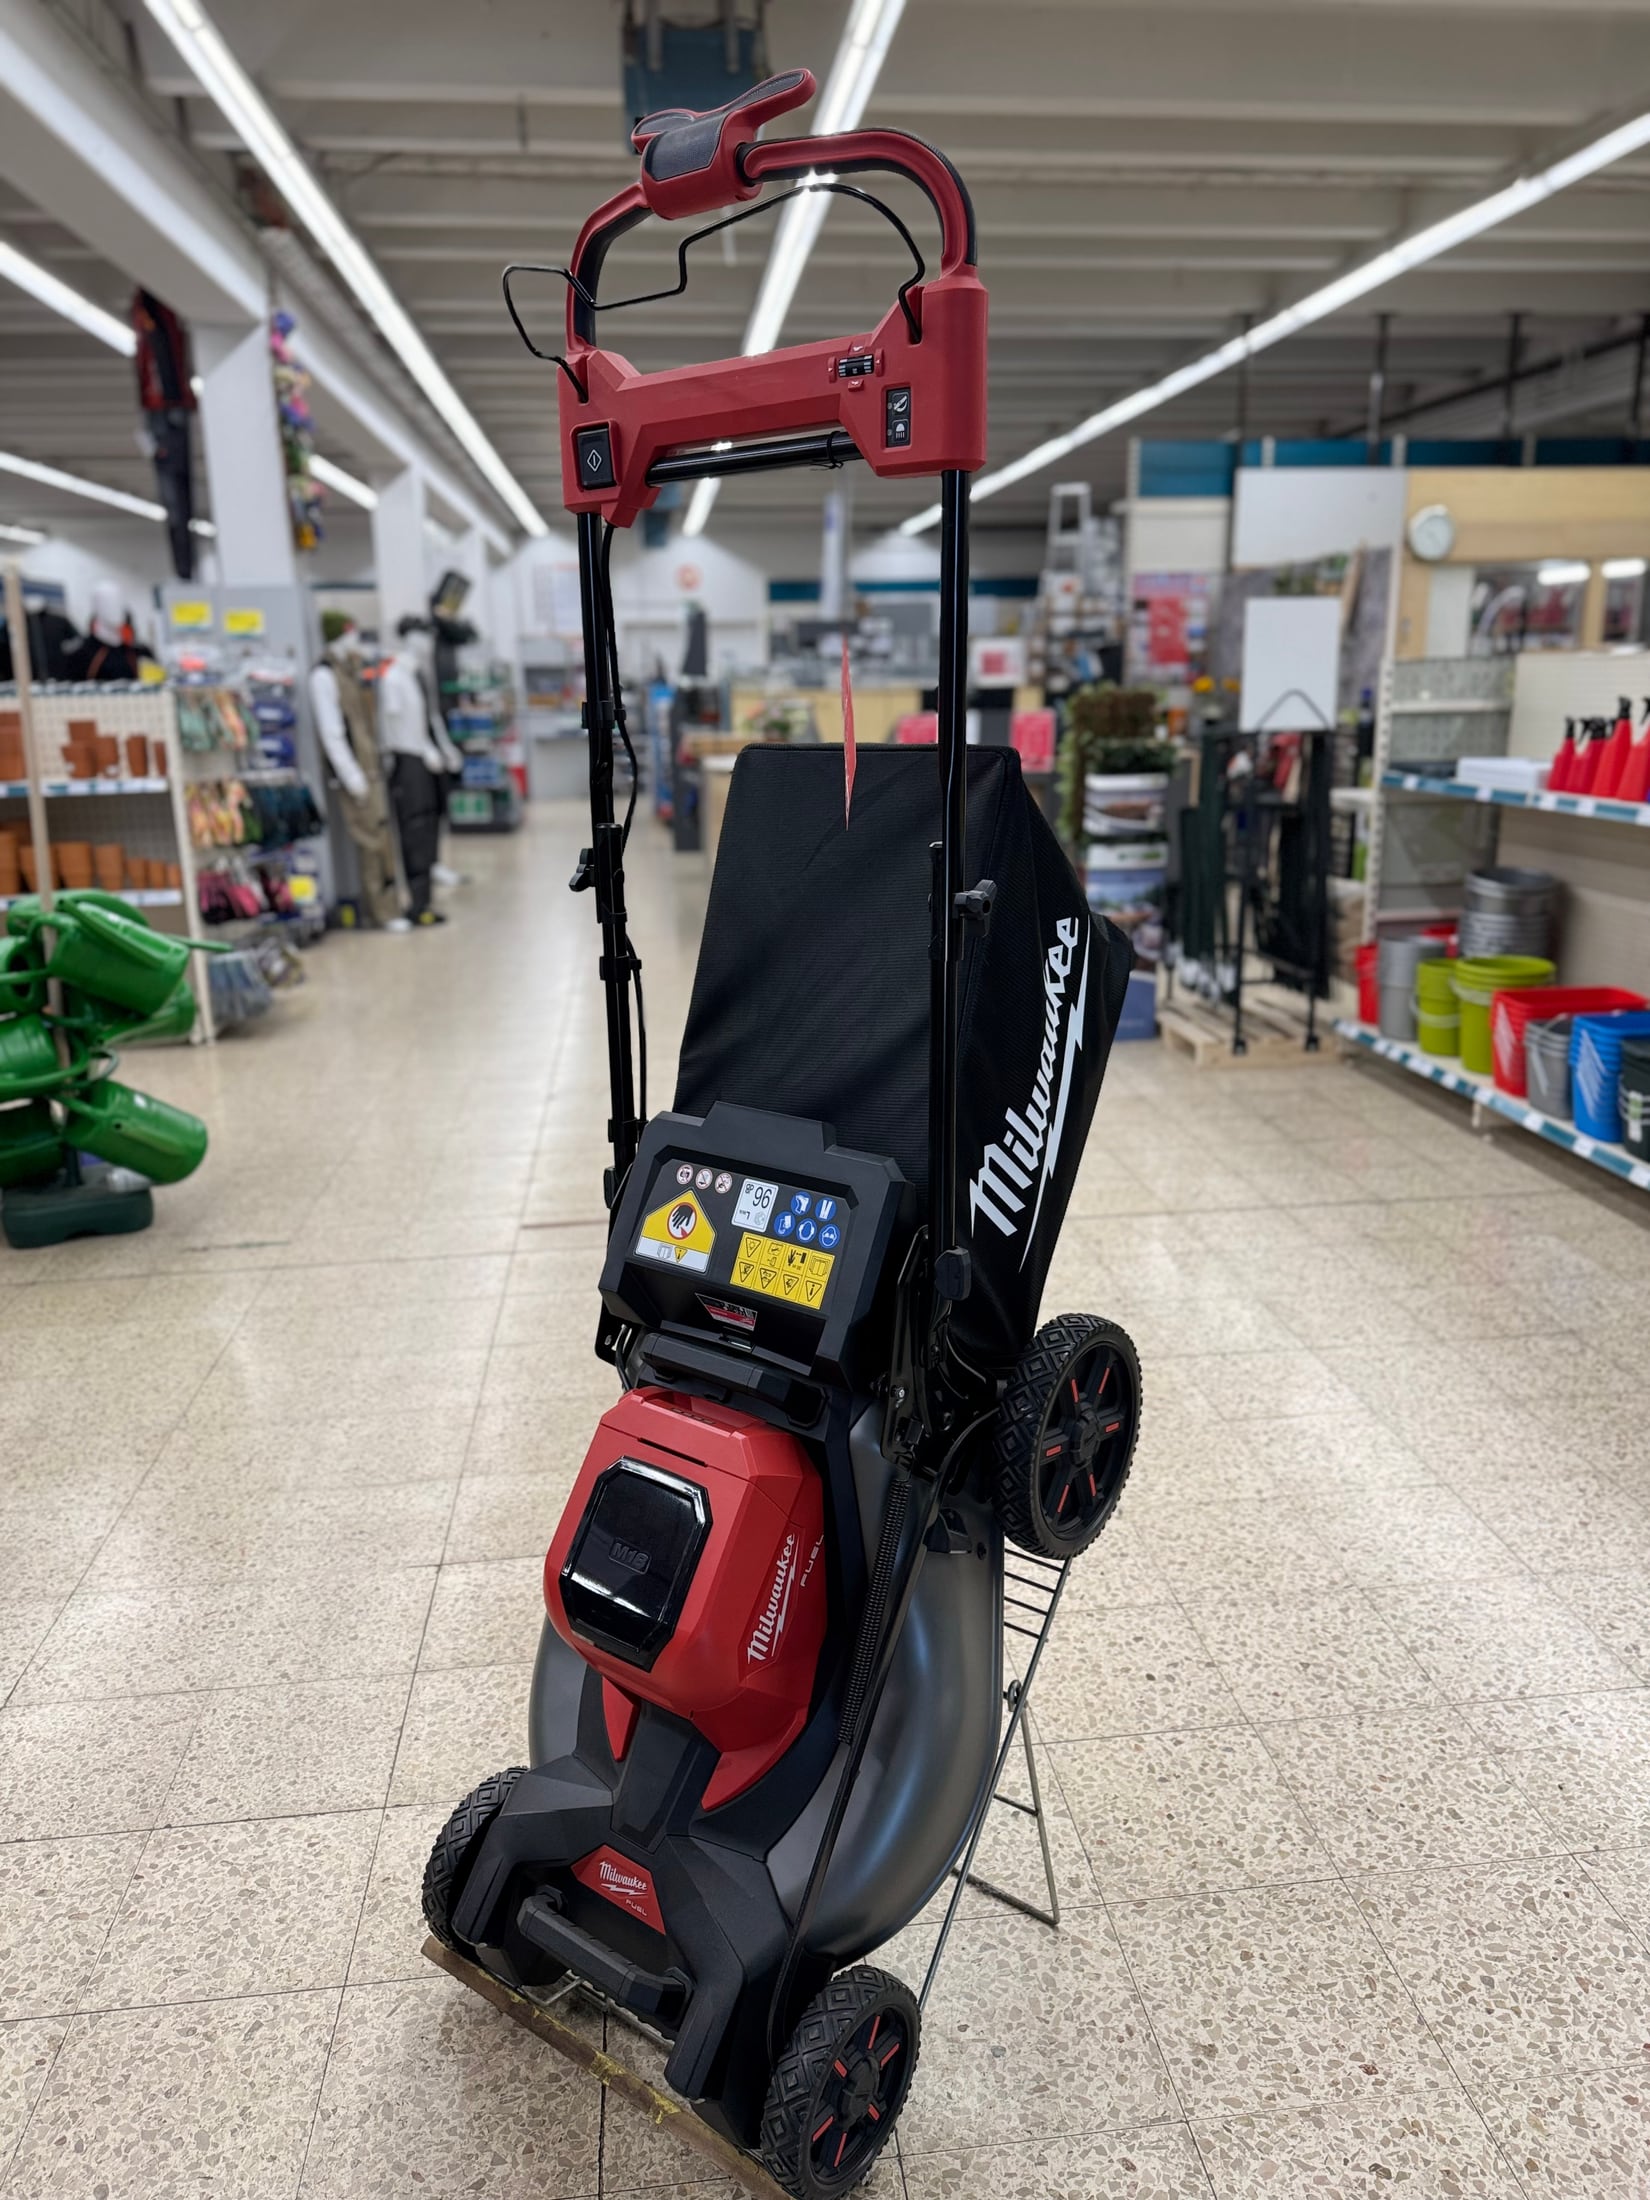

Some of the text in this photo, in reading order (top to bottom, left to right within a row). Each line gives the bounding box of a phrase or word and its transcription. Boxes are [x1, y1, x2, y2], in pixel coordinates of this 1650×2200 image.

[969, 917, 1079, 1239] Milwaukee
[752, 1186, 773, 1209] 96
[611, 1542, 649, 1570] M18
[800, 1534, 824, 1587] FUEL
[747, 1533, 795, 1664] Milwaukee
[599, 1861, 648, 1890] Milwaukee
[626, 1899, 647, 1916] FUEL
